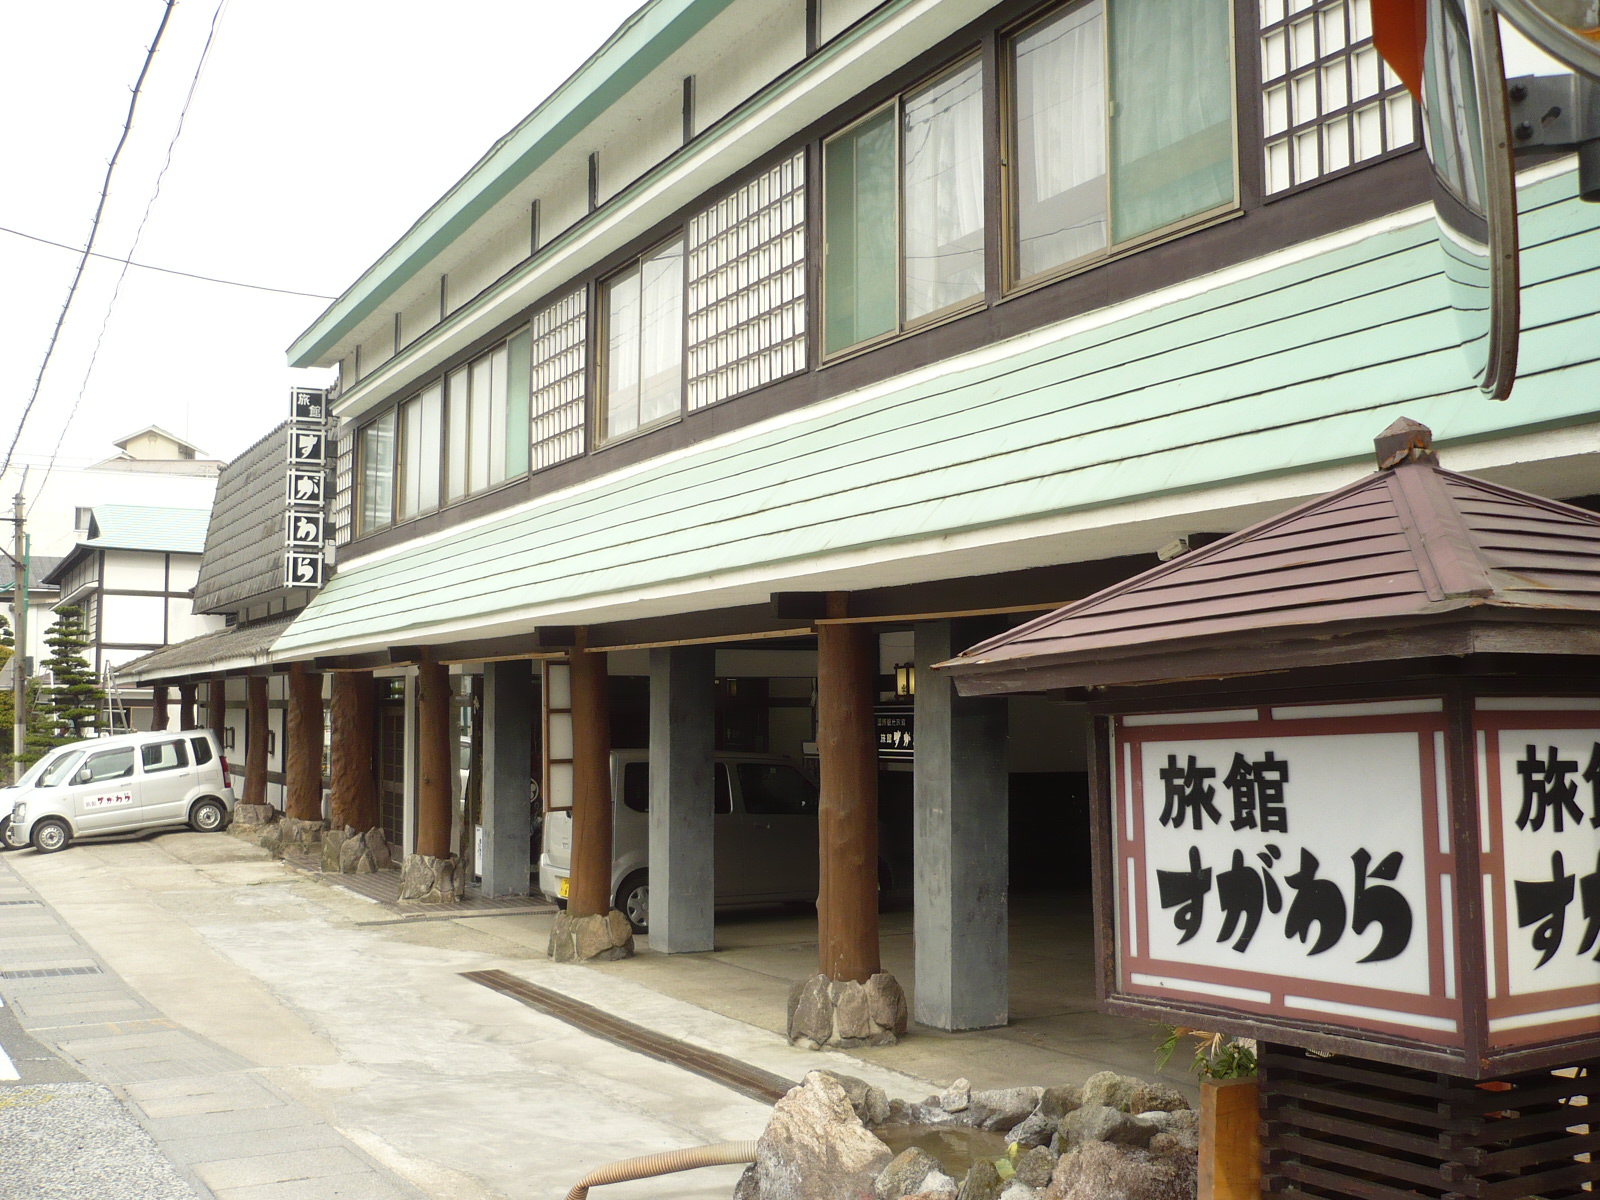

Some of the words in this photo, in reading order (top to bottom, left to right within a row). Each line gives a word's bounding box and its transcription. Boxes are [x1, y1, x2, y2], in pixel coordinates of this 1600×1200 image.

[298, 393, 321, 418] 旅館
[296, 434, 319, 583] すがわら
[893, 729, 915, 748] すが
[1158, 751, 1289, 834] 旅館
[1515, 741, 1600, 833] 旅
[1156, 844, 1413, 964] すがわら
